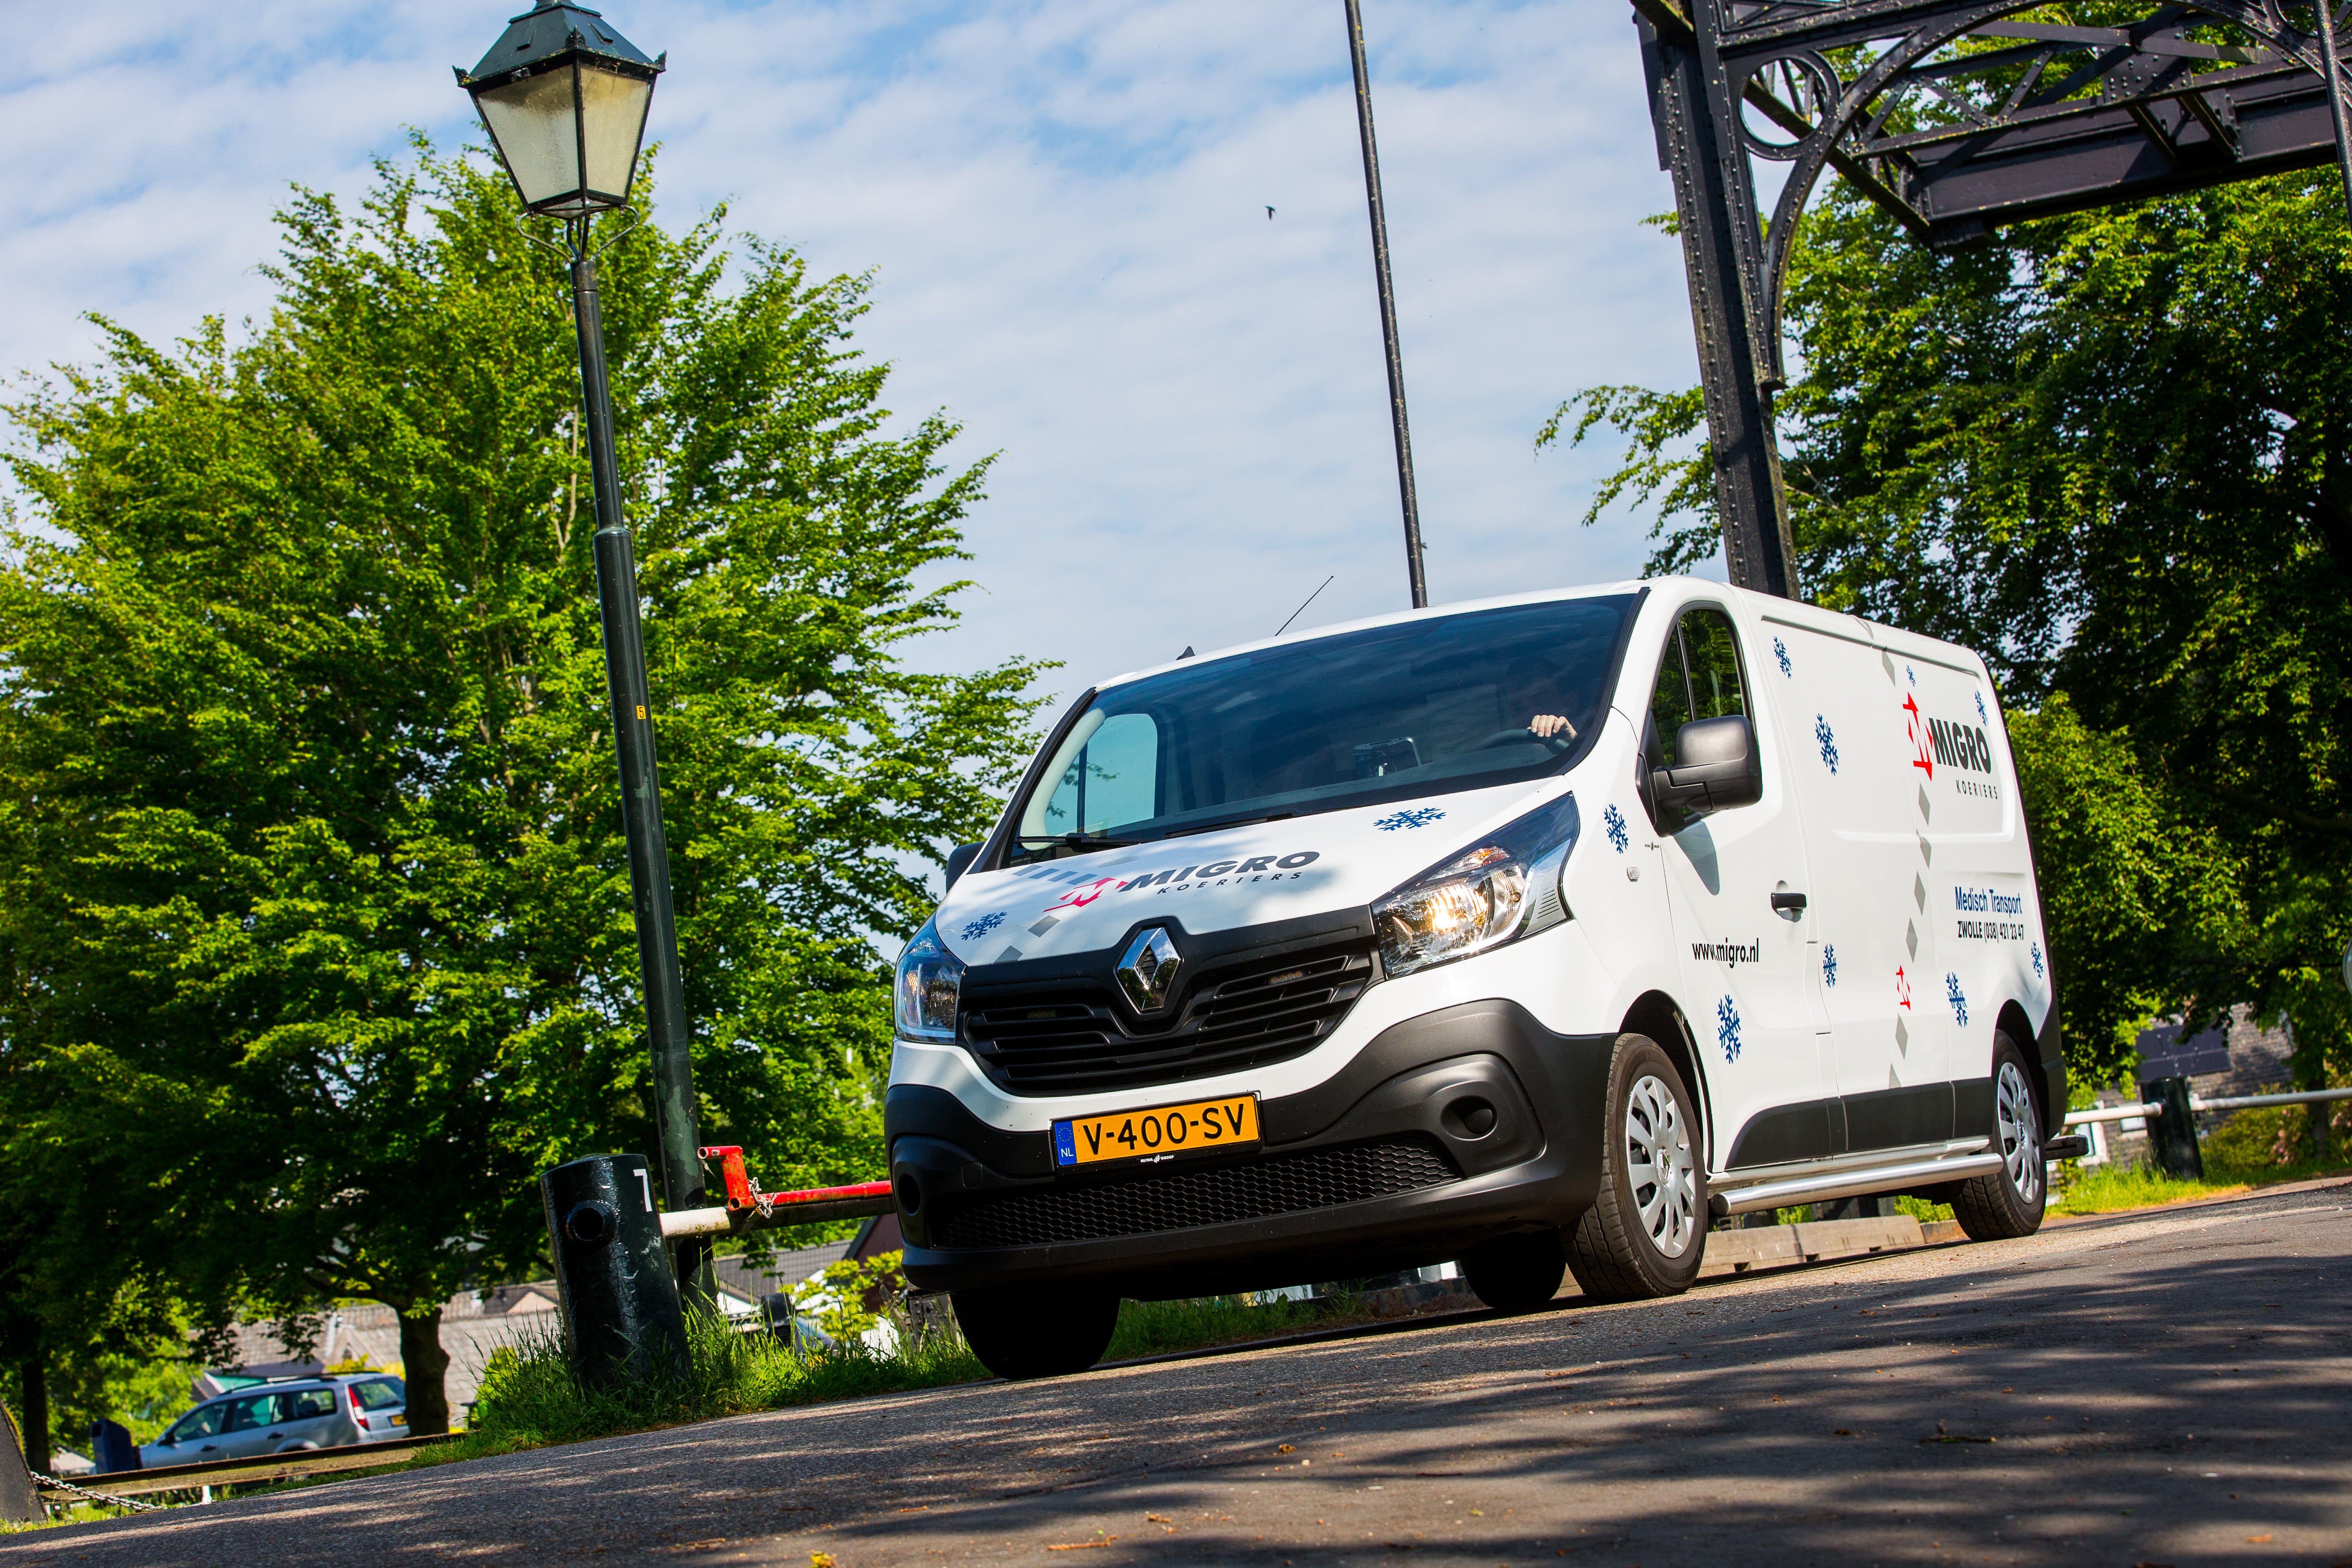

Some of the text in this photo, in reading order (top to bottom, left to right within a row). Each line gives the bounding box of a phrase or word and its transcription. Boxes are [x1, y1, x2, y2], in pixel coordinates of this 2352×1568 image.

[639, 707, 644, 718] 5
[1929, 717, 1991, 774] MIGRO
[1956, 780, 1998, 800] KOERIERS
[1118, 851, 1320, 892] MIGRO
[1157, 871, 1302, 895] KOERIERS
[1955, 886, 2022, 918] Medisch Transport
[1958, 920, 2024, 944] ZWOLLE (038) 421 23 47
[1692, 937, 1759, 969] www.migro.nl
[1083, 1103, 1244, 1155] V-400-SV
[1060, 1147, 1074, 1158] NL
